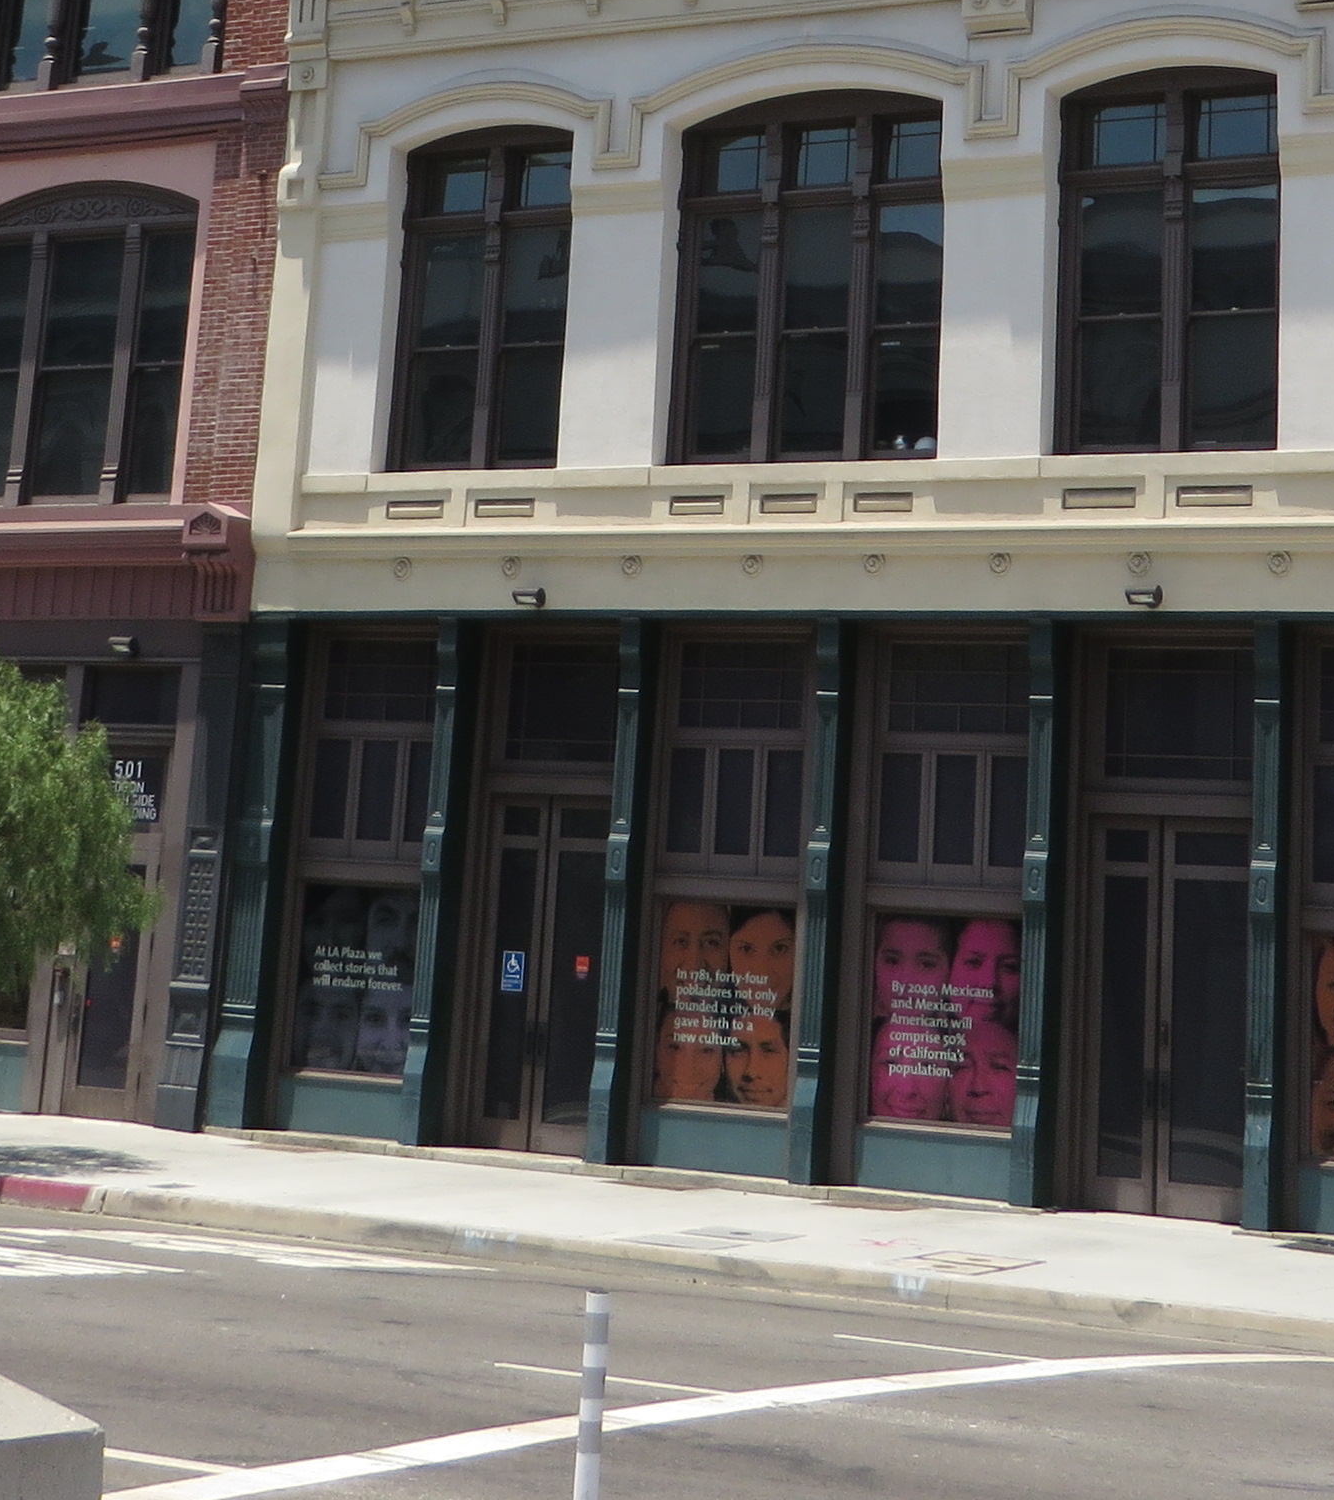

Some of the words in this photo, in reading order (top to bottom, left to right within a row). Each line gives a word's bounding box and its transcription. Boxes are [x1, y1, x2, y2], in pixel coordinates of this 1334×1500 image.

[114, 760, 143, 779] 501
[314, 946, 326, 956] At
[327, 946, 340, 958] LA
[341, 946, 366, 959] Plaza
[367, 951, 383, 960] we
[313, 959, 343, 972] collect
[345, 963, 376, 975] stories
[378, 963, 398, 976] that
[312, 974, 331, 986] will
[332, 976, 367, 989] endure
[368, 977, 404, 991] forever.
[676, 968, 687, 979] In
[690, 968, 713, 982] 1781,
[715, 969, 769, 985] forty-four
[676, 984, 733, 998] pobladores
[734, 987, 752, 999] not
[754, 988, 778, 1003] only
[892, 980, 906, 996] By
[908, 983, 939, 996] 2040,
[941, 983, 994, 998] Mexicans
[675, 998, 718, 1013] founded
[720, 1005, 727, 1013] a
[729, 1003, 751, 1018] city,
[753, 1004, 776, 1020] they
[890, 997, 913, 1009] and
[915, 998, 962, 1012] Mexican
[674, 1016, 699, 1029] gave
[702, 1015, 729, 1029] birth
[732, 1018, 744, 1031] to
[746, 1022, 754, 1031] a
[890, 1012, 948, 1028] Americans
[950, 1017, 973, 1030] will
[673, 1032, 696, 1043] new
[698, 1032, 741, 1047] culture.
[889, 1031, 941, 1045] comprise
[943, 1033, 967, 1047] 50%
[889, 1044, 901, 1057] of
[903, 1046, 965, 1062] California's
[888, 1062, 954, 1078] population.
